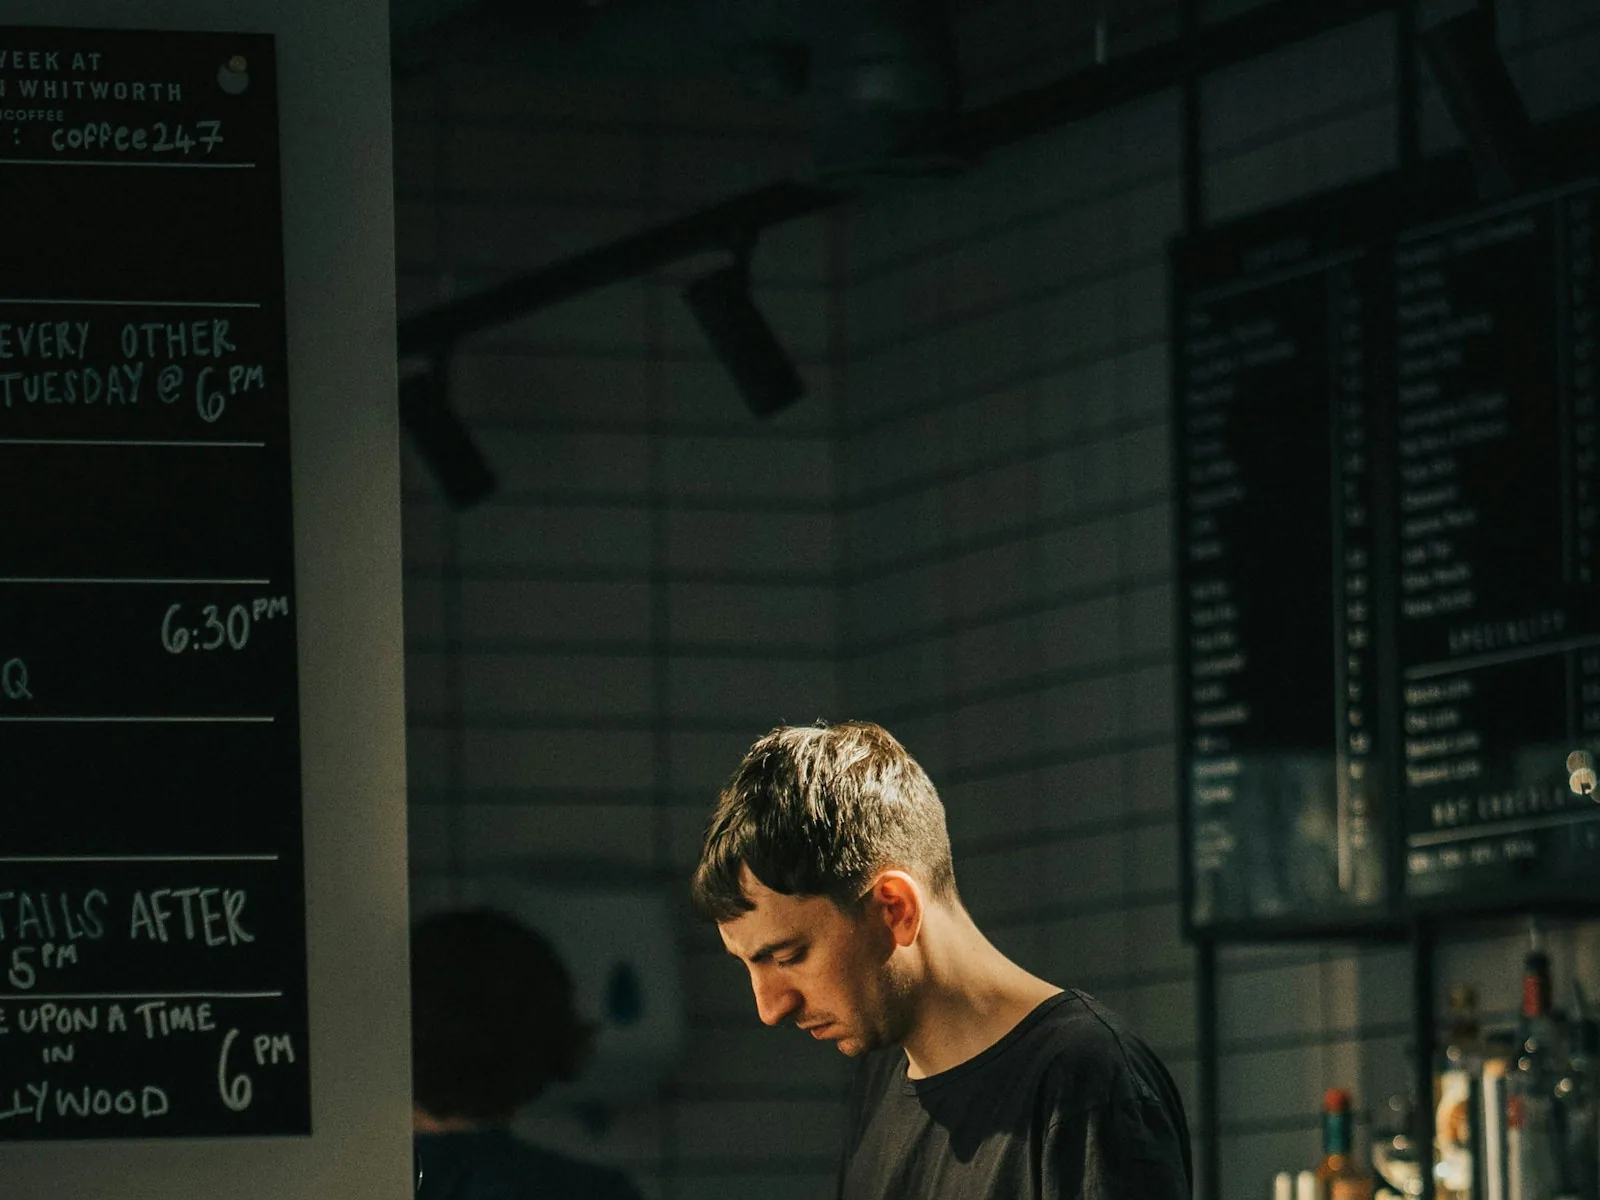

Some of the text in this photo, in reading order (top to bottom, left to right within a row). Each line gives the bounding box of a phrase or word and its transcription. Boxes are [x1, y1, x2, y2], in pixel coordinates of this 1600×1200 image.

[0, 51, 102, 71] EEK AT
[19, 79, 182, 102] WHITWORTH
[0, 109, 65, 122] COFFEE
[0, 319, 236, 360] EVERY OTHER
[0, 361, 144, 408] TUESDAY
[157, 364, 184, 404] @
[130, 887, 255, 947] AFTER
[18, 1003, 98, 1034] UPON
[107, 1003, 127, 1033] A
[134, 1001, 216, 1039] TIME
[42, 1042, 75, 1064] IN
